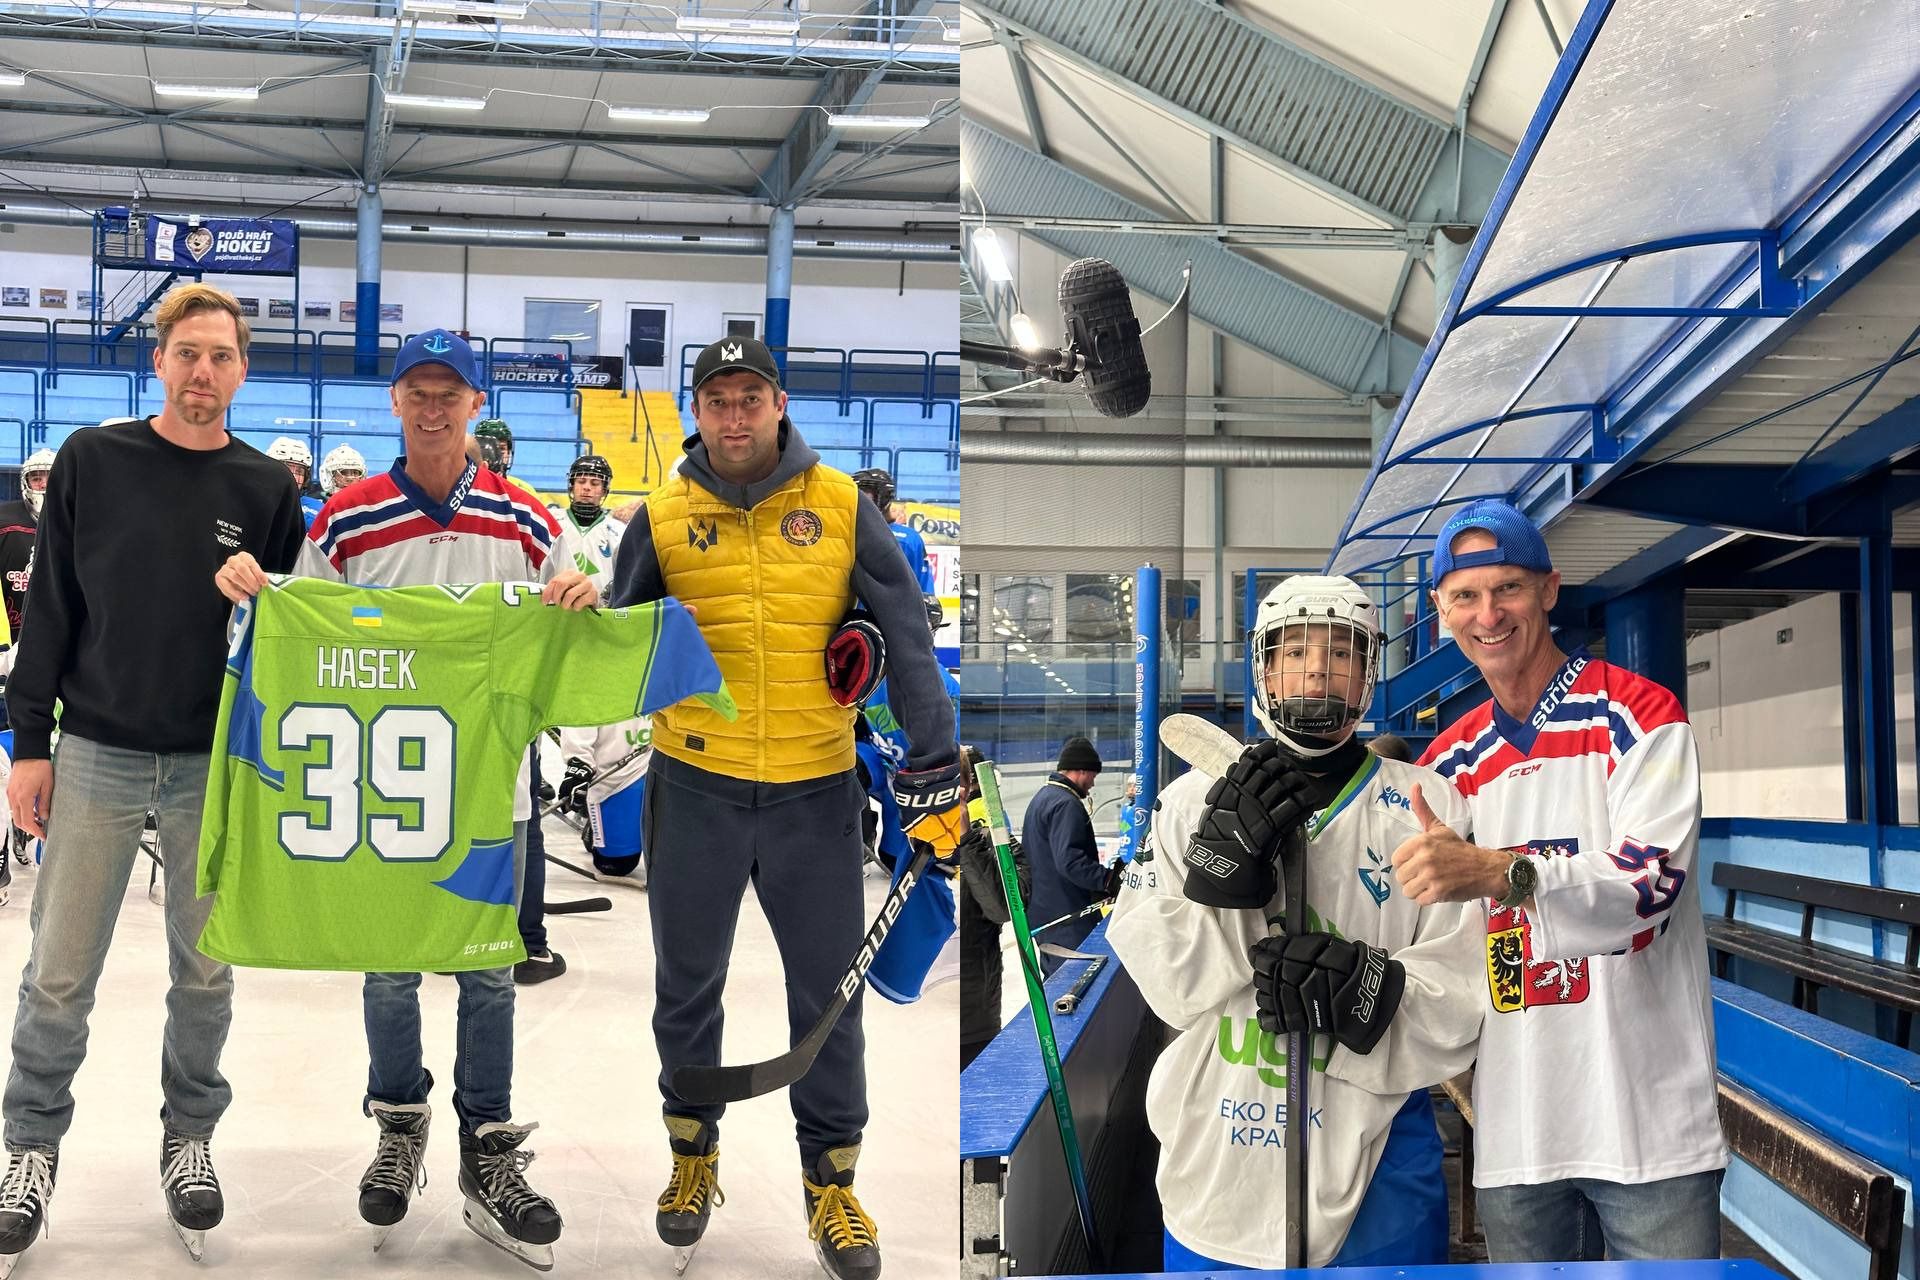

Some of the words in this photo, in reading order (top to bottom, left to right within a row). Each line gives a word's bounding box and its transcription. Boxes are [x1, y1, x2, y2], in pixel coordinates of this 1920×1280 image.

[218, 230, 244, 240] POJĎ
[245, 231, 273, 241] HRÁT
[215, 241, 271, 253] HOKEJ
[494, 371, 559, 383] HOCKEY
[429, 535, 459, 544] CCM
[317, 645, 418, 690] HASEK
[1531, 656, 1588, 730] střída
[1508, 763, 1542, 779] CCM
[278, 701, 458, 863] 39
